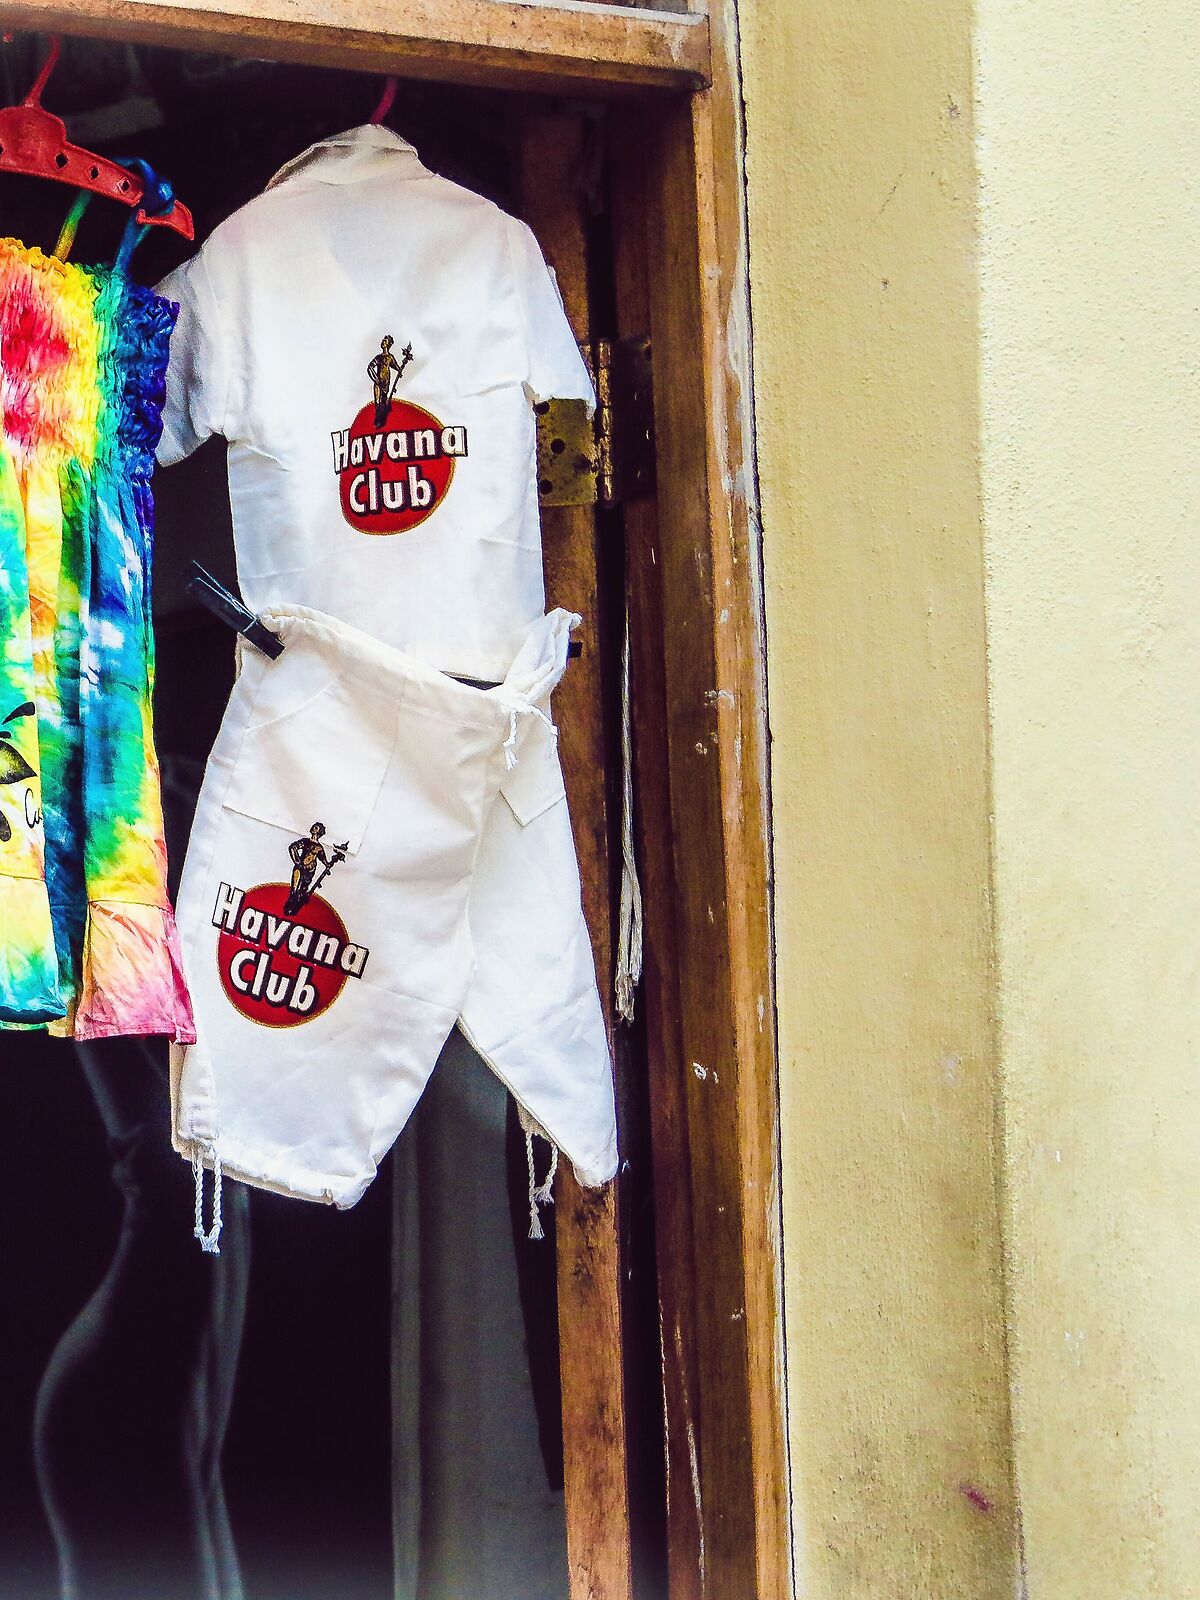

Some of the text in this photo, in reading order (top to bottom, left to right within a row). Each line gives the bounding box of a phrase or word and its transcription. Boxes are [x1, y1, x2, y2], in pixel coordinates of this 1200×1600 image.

[331, 426, 468, 474] Havana
[349, 464, 435, 516] Club
[212, 882, 369, 979] Havana
[229, 949, 320, 1015] Club
